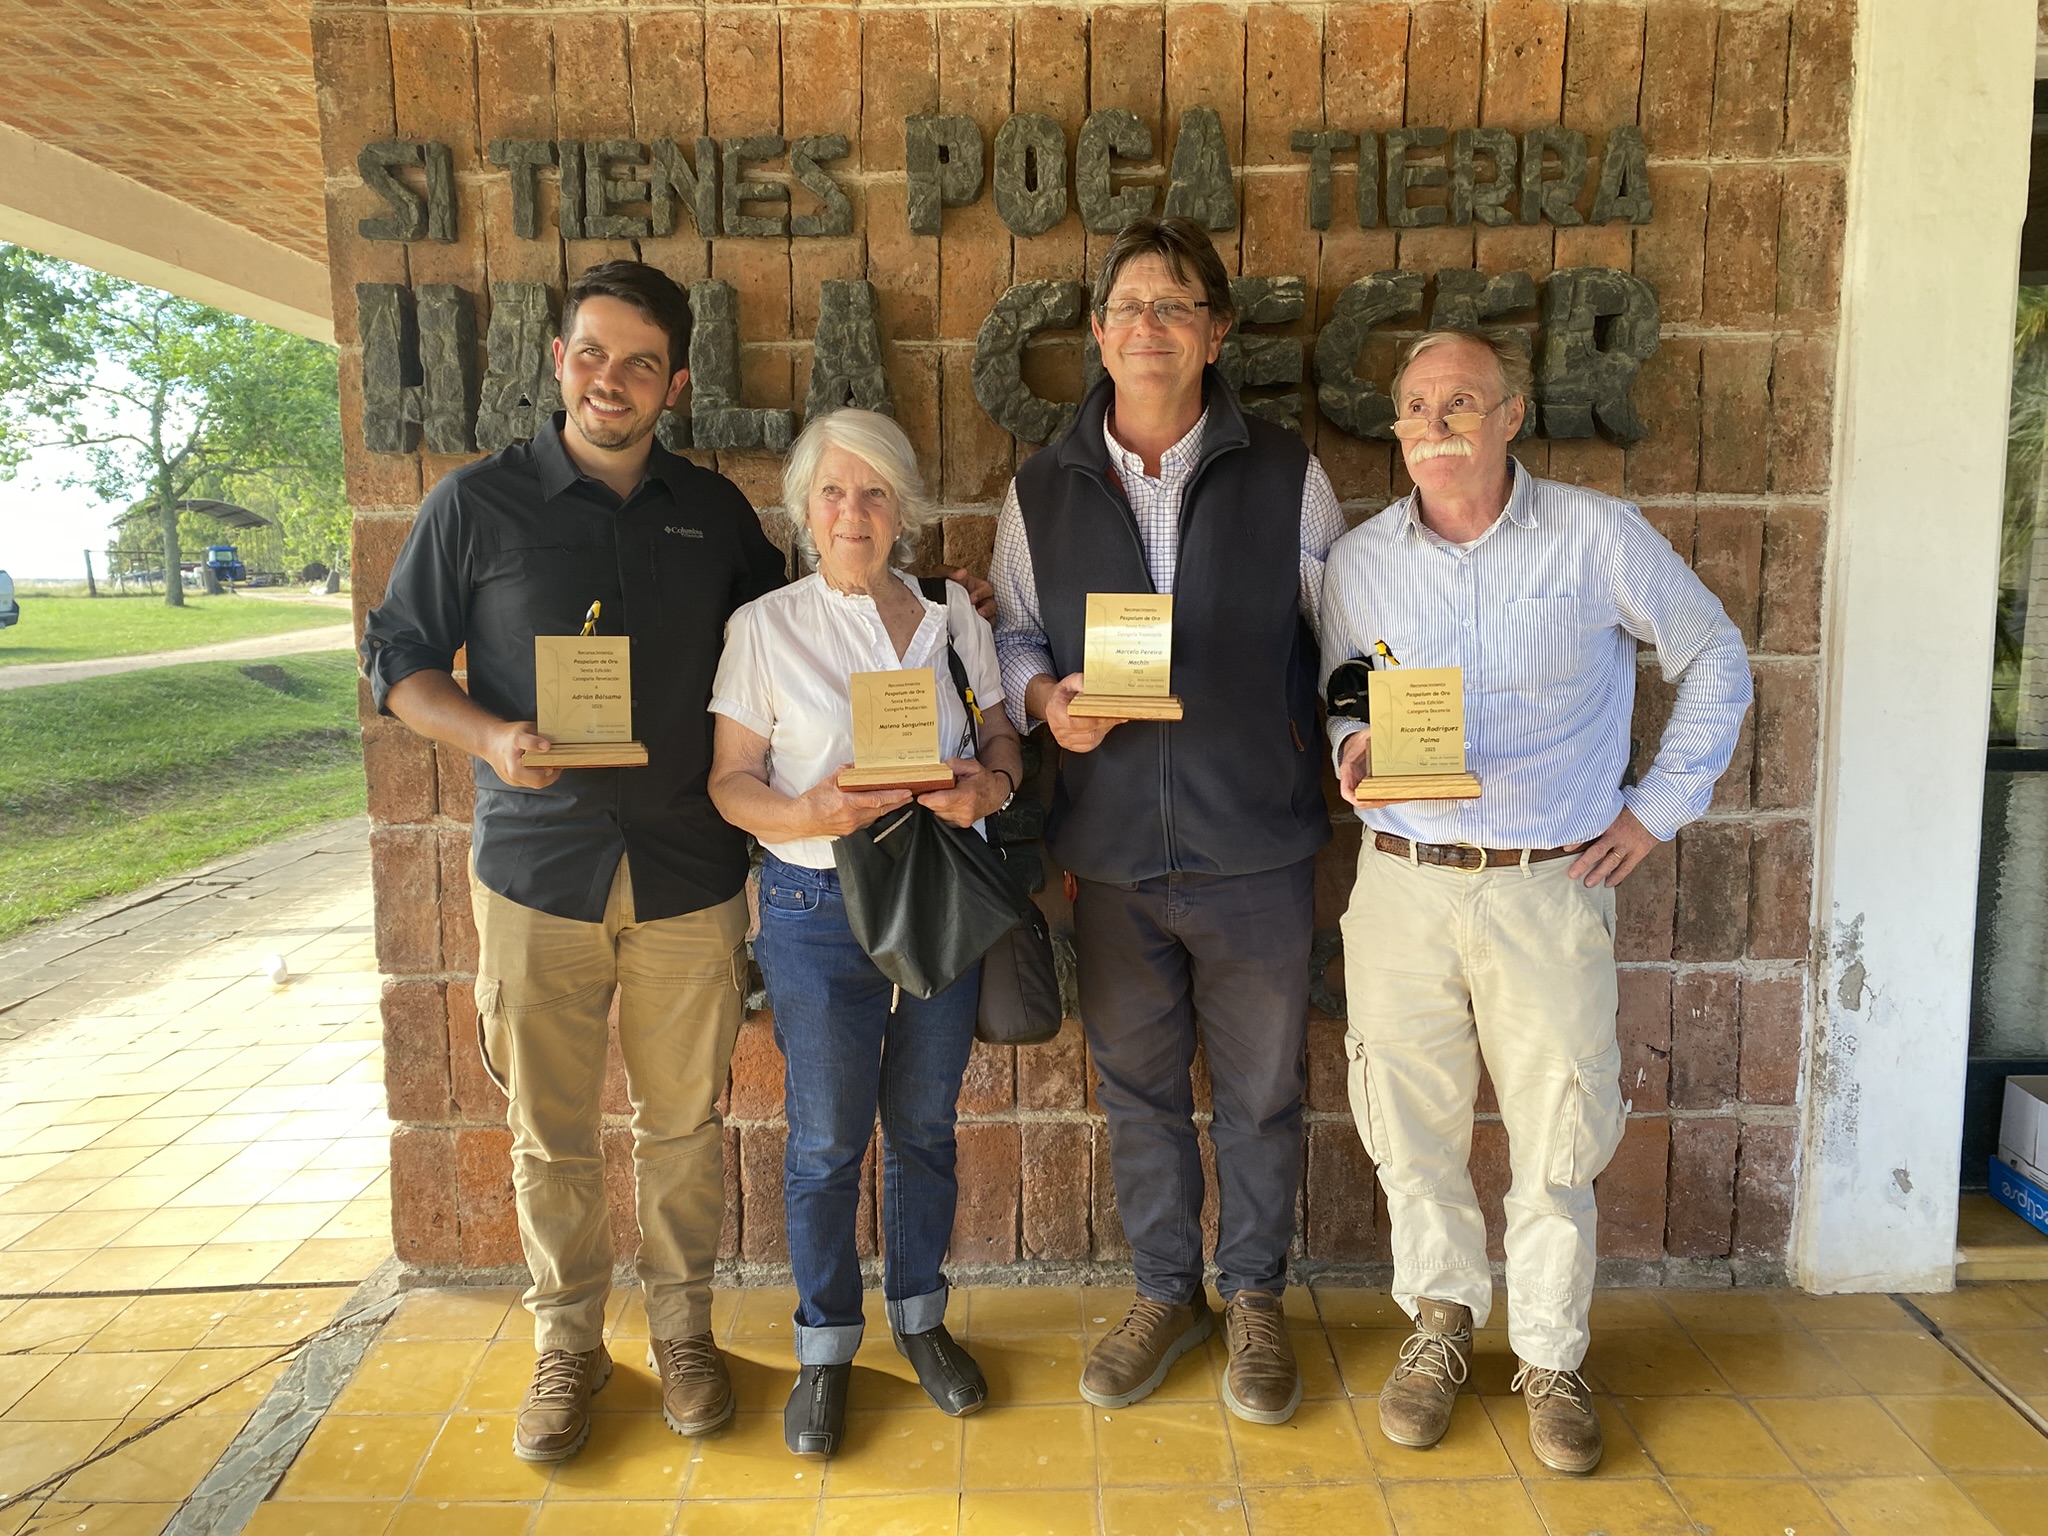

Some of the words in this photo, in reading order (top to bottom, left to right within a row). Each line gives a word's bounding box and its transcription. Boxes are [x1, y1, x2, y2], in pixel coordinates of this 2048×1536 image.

[357, 139, 459, 243] SI
[489, 132, 855, 241] TIENES
[904, 106, 1237, 238] POCA
[1289, 124, 1654, 232] TIERRA
[356, 279, 895, 454] HALA
[972, 266, 1660, 447] CECER
